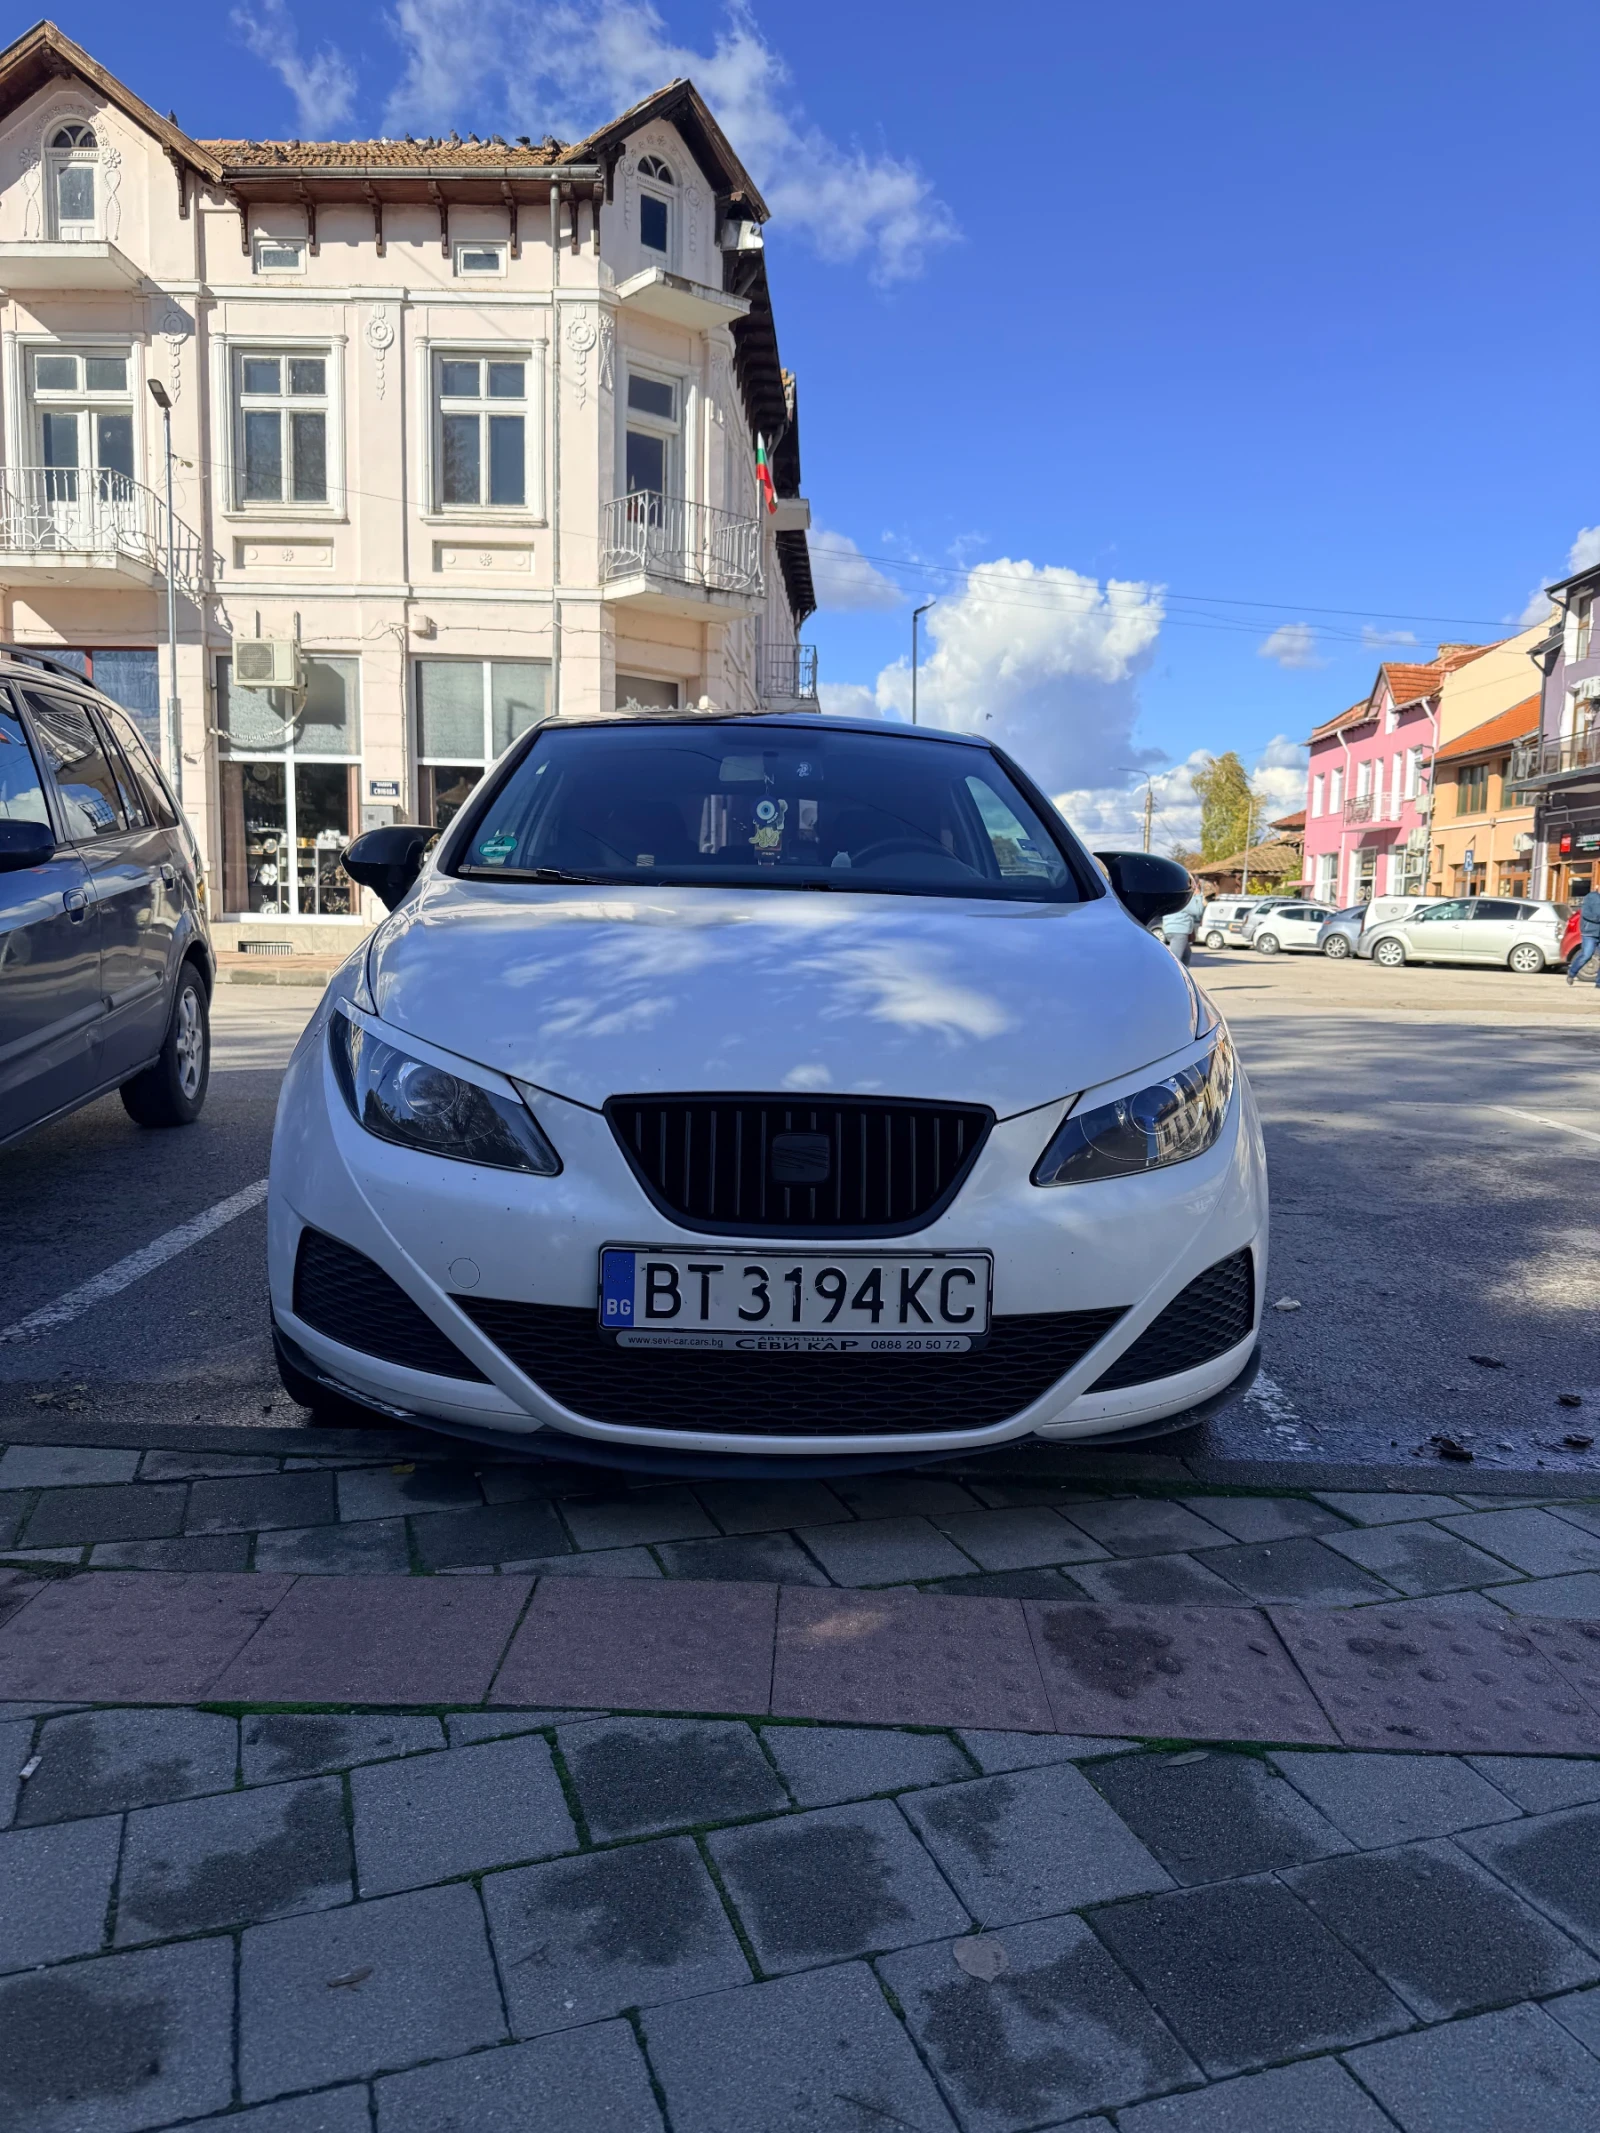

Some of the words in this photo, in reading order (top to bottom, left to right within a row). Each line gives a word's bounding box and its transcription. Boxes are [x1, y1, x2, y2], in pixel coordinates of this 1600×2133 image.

[645, 1263, 725, 1320] BT
[738, 1265, 885, 1324] 3194
[900, 1267, 976, 1324] KC
[606, 1298, 631, 1316] BG
[628, 1336, 723, 1348] www.sevi-car.cars.bg
[807, 1340, 859, 1351] КАР
[870, 1340, 901, 1350] 0888
[906, 1340, 922, 1350] 20
[925, 1340, 941, 1350] 50
[945, 1340, 961, 1350] 72
